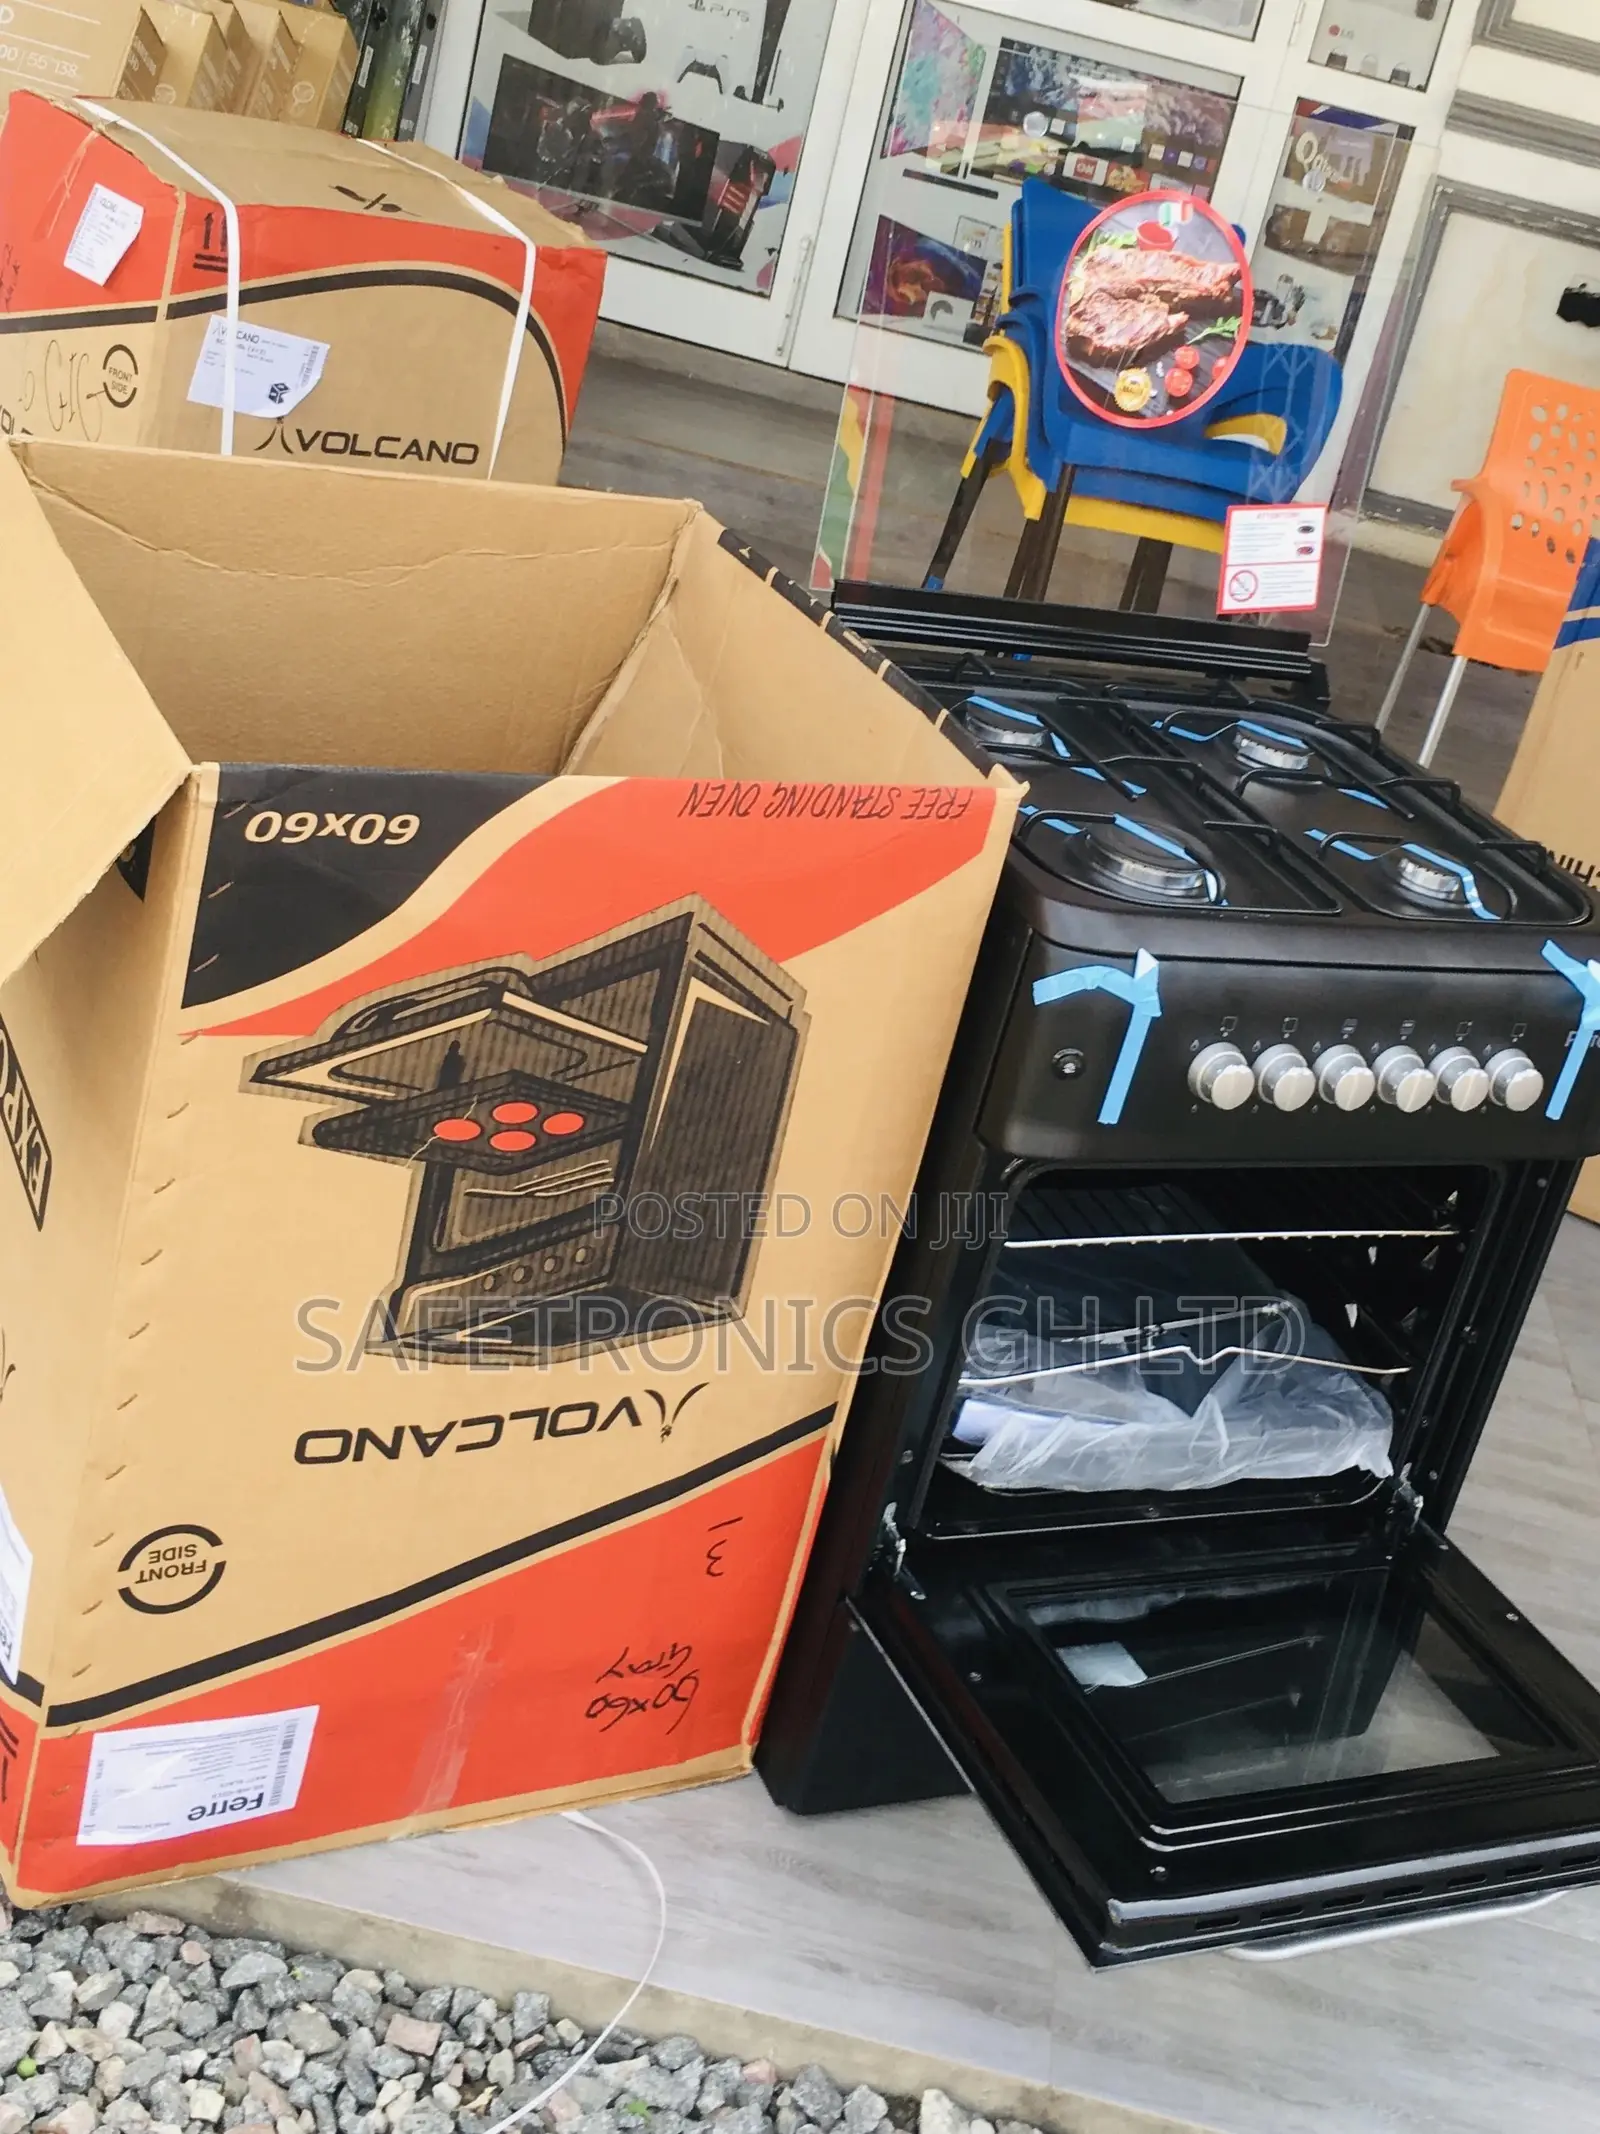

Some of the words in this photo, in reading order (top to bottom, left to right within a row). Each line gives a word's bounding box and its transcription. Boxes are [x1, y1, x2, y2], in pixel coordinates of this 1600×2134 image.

[220, 324, 260, 344] VCANO
[108, 366, 133, 383] FRONT
[111, 381, 128, 395] SIDE
[296, 428, 479, 465] VOLCANO
[677, 781, 762, 818] OVEN
[763, 782, 901, 820] STANDING
[900, 788, 973, 820] FREE
[294, 1396, 642, 1465] VOLCANO
[148, 1543, 198, 1564] SIDE
[134, 1559, 207, 1585] FRONT
[187, 1792, 265, 1822] Ferre
